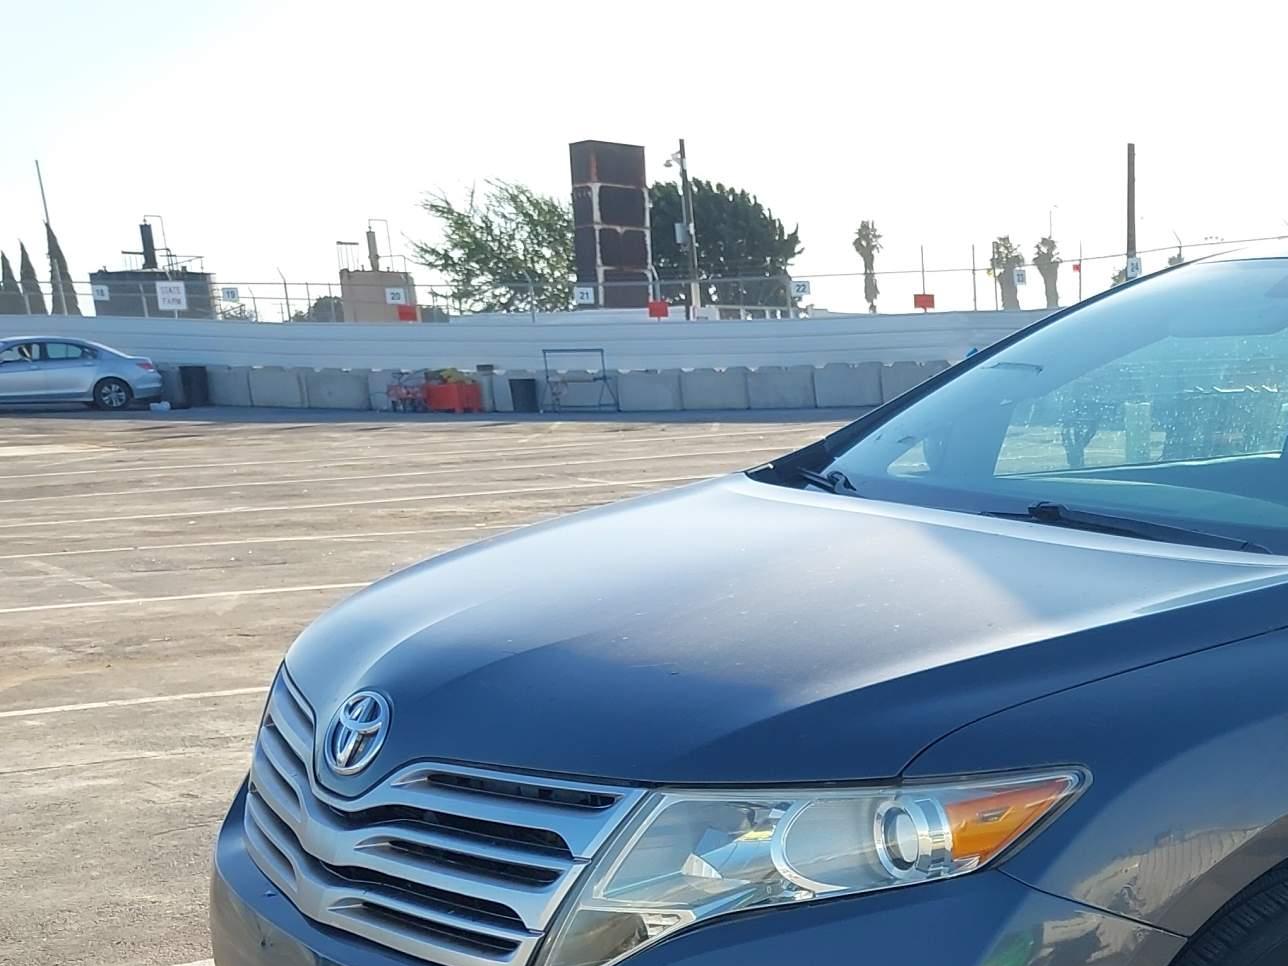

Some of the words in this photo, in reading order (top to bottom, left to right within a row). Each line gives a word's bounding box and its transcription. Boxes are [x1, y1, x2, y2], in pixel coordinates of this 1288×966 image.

[795, 283, 807, 293] 22
[390, 291, 401, 301] 20
[579, 291, 590, 300] 21
